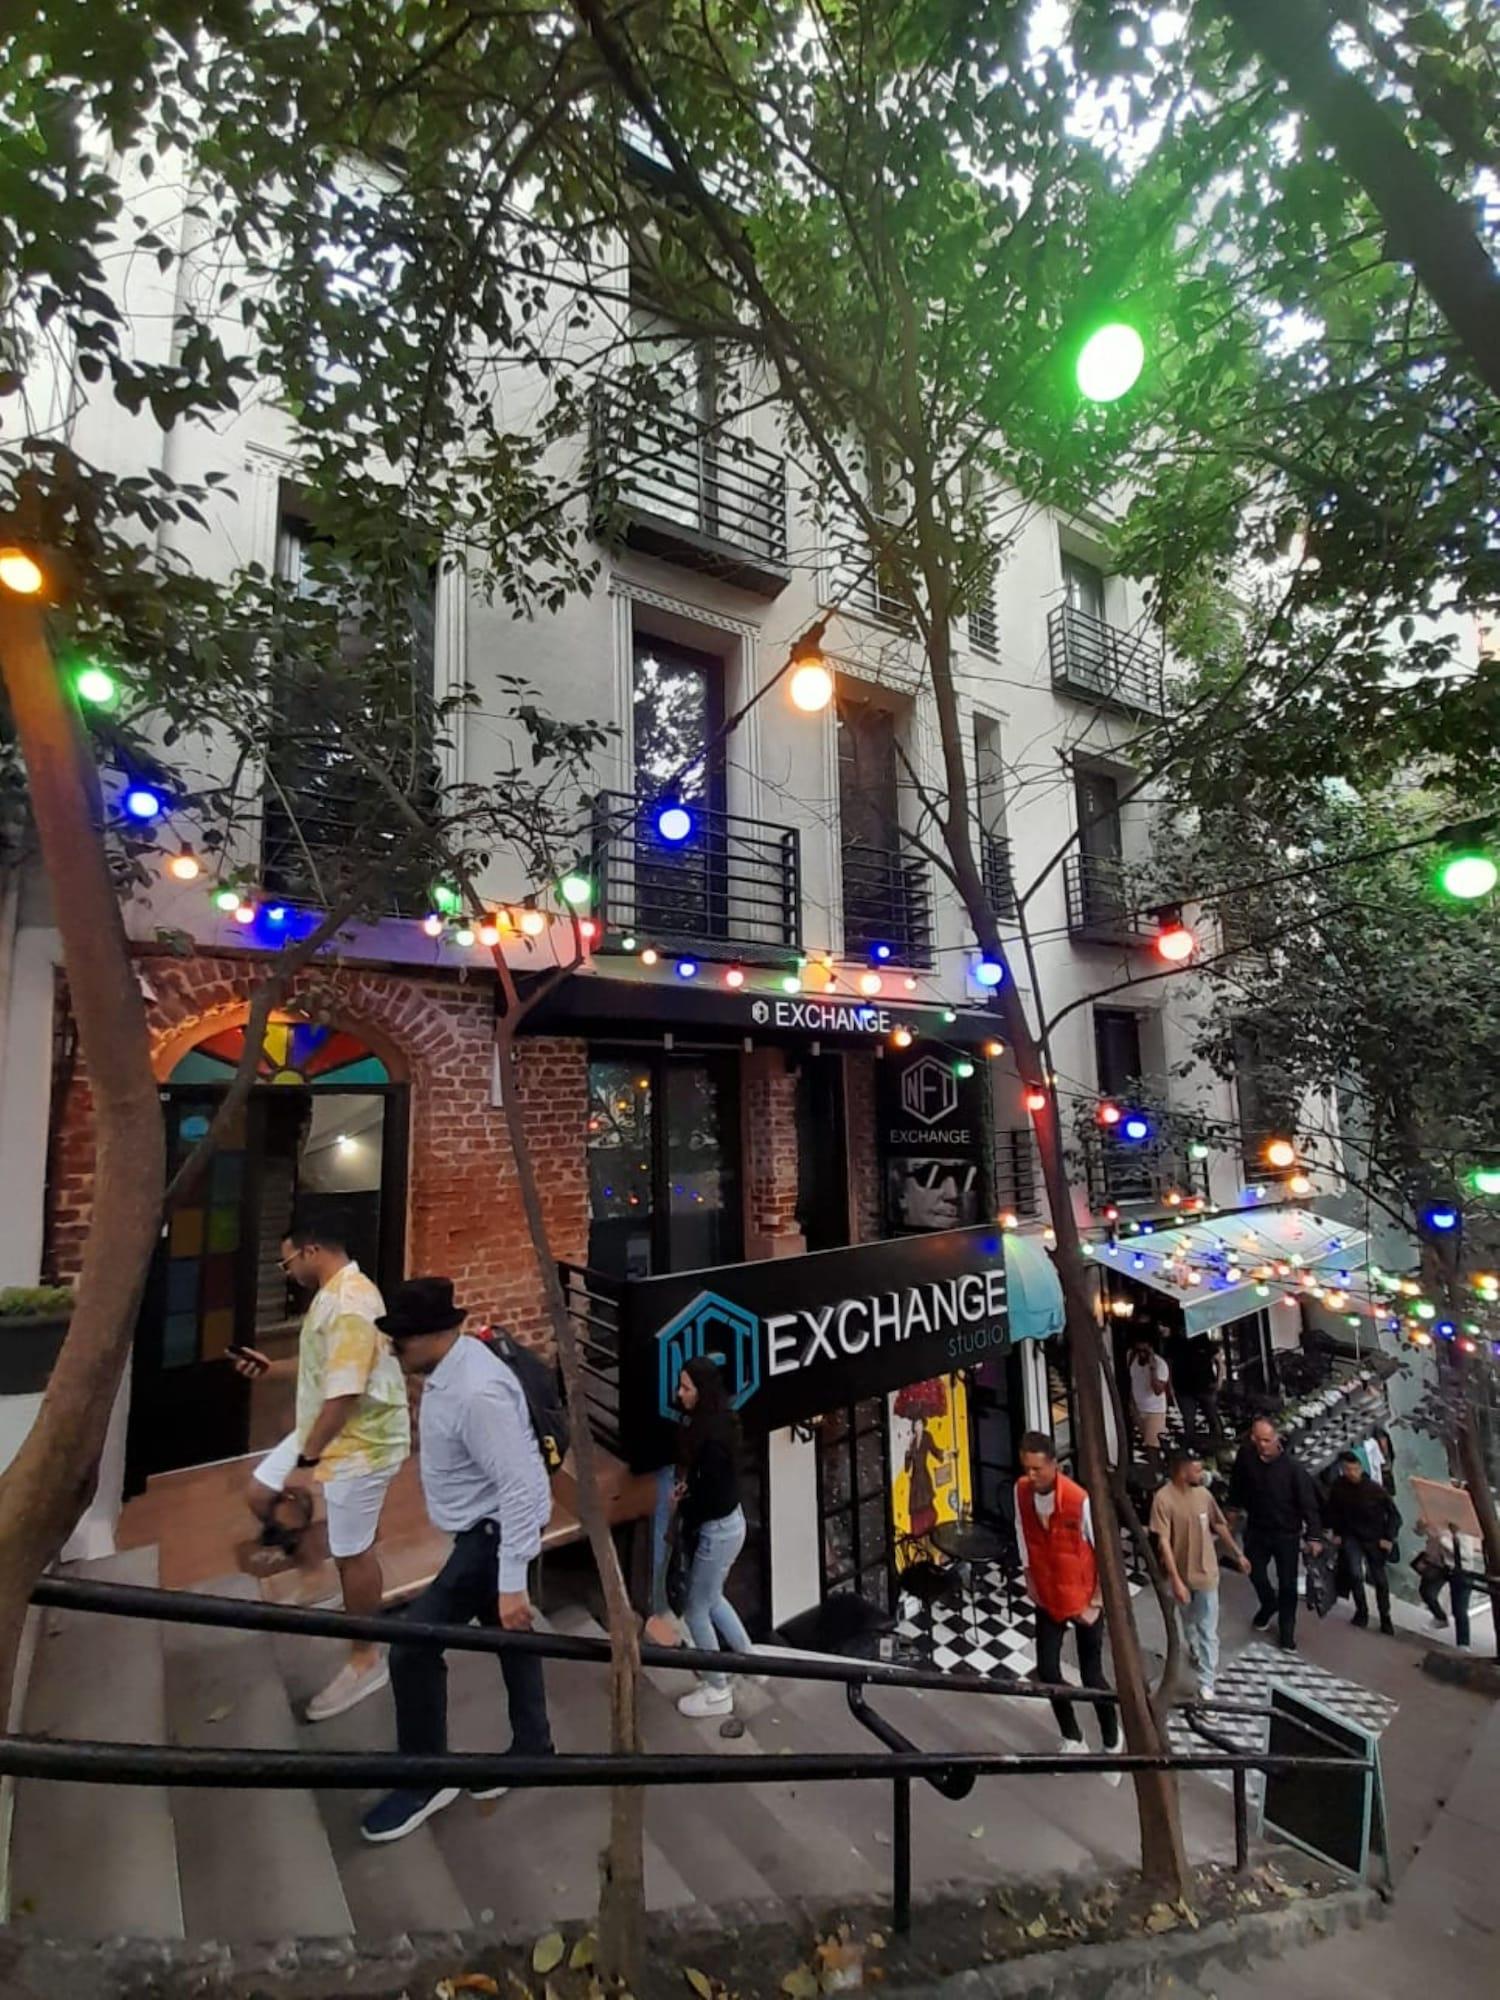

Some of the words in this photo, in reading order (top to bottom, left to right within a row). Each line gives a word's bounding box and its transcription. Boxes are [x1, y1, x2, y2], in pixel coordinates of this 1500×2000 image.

[775, 1001, 891, 1033] EXCHANGE
[906, 1062, 954, 1113] NFT
[890, 1129, 971, 1144] EXCHANGE
[764, 1270, 1008, 1376] EXCHANGE
[946, 1323, 1004, 1358] studio
